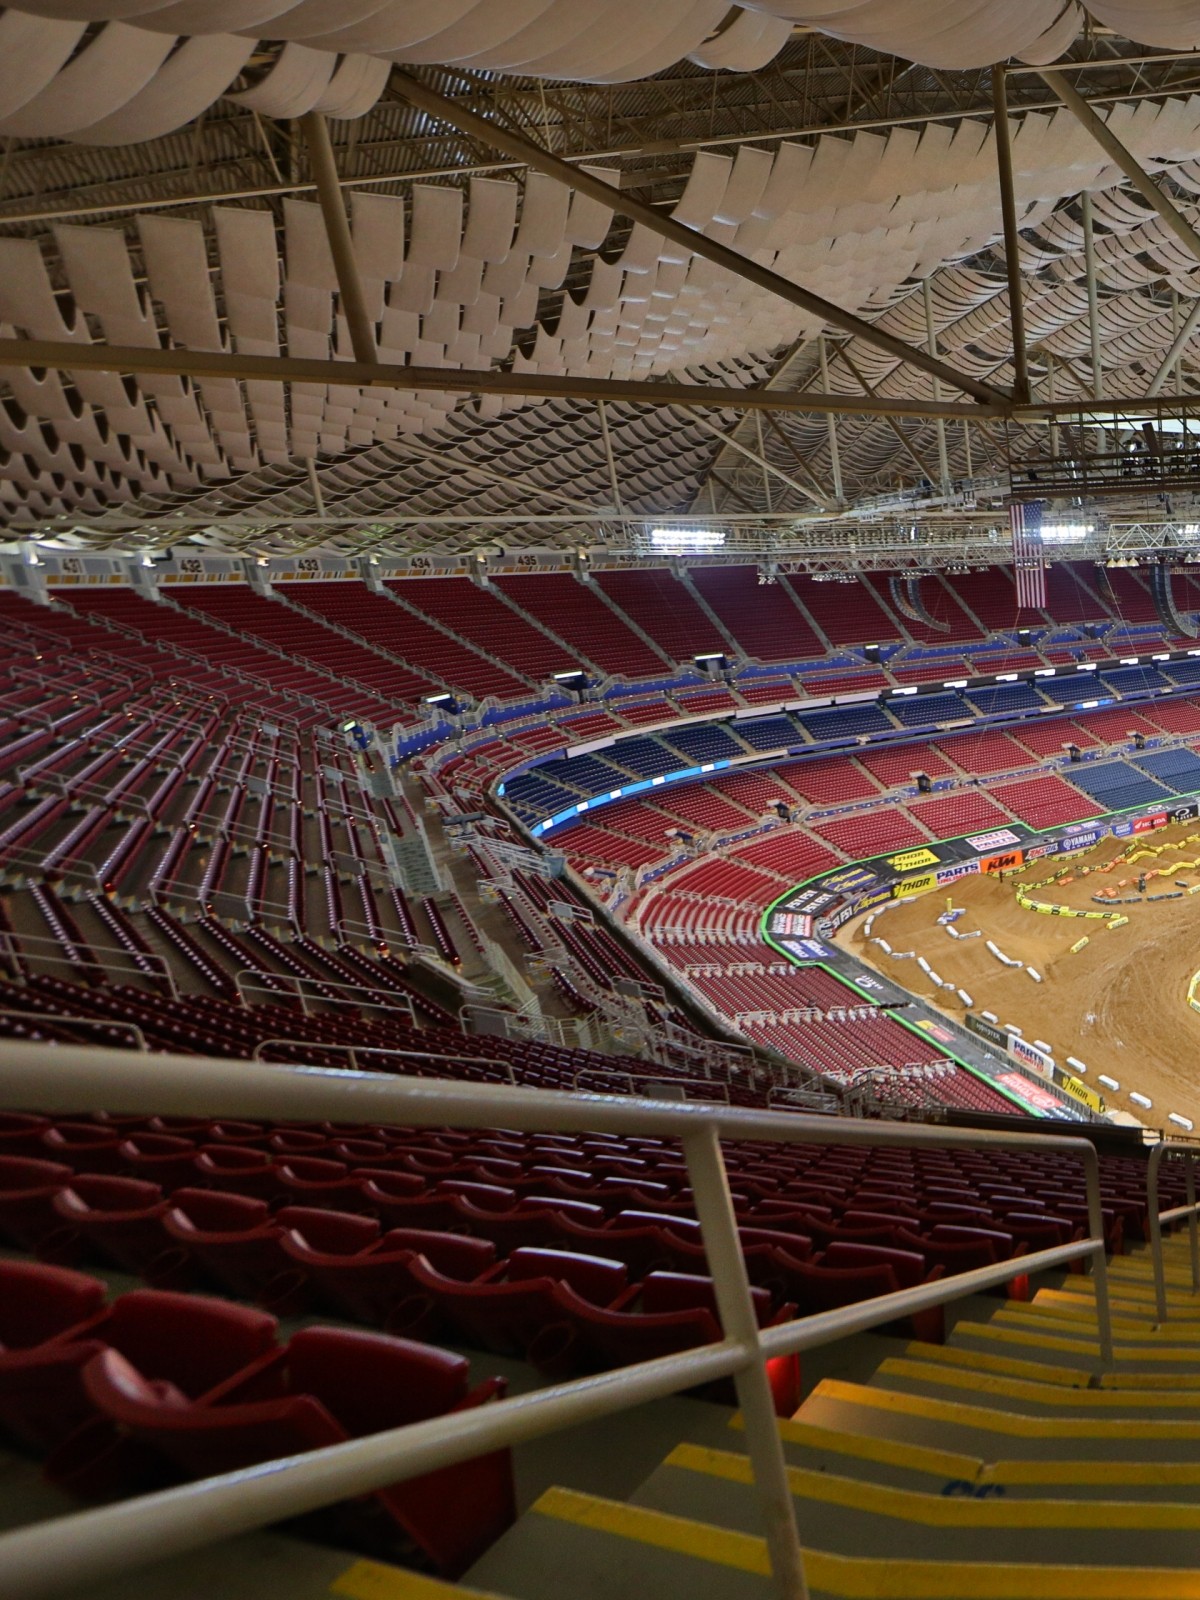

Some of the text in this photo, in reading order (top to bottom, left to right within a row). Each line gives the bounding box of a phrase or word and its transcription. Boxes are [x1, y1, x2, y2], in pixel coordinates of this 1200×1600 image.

[62, 558, 81, 574] 431
[180, 559, 202, 573] 432
[298, 560, 319, 572] 433
[411, 558, 430, 569] 434
[518, 556, 537, 566] 435
[1070, 832, 1096, 847] YAMAHA
[987, 854, 1017, 871] KTM
[936, 862, 979, 880] PARTS
[902, 877, 931, 892] THOR
[840, 906, 853, 922] FS1
[1014, 1040, 1044, 1065] PARTS
[1069, 1082, 1089, 1100] THOR
